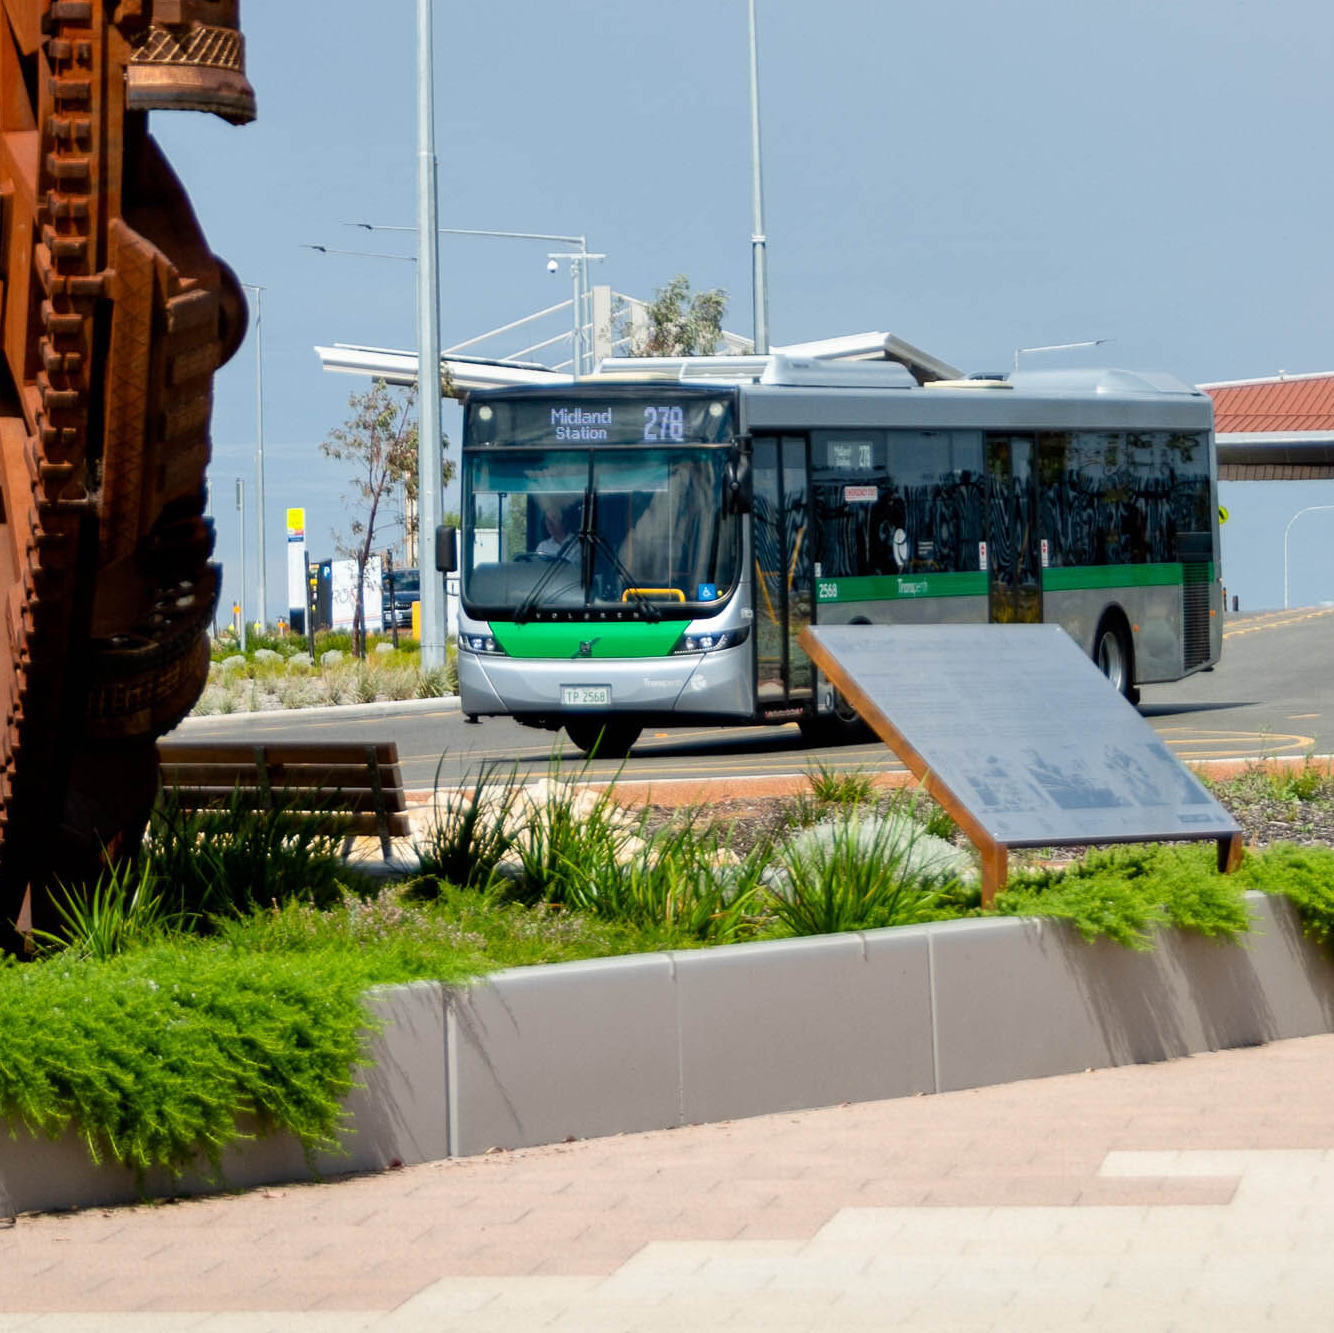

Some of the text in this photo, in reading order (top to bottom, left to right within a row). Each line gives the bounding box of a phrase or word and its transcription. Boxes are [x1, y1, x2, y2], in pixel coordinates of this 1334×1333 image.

[551, 407, 611, 424] Midland
[643, 406, 684, 442] 278
[555, 426, 607, 440] Station
[819, 583, 837, 598] 2568
[566, 691, 605, 703] TP 2568
